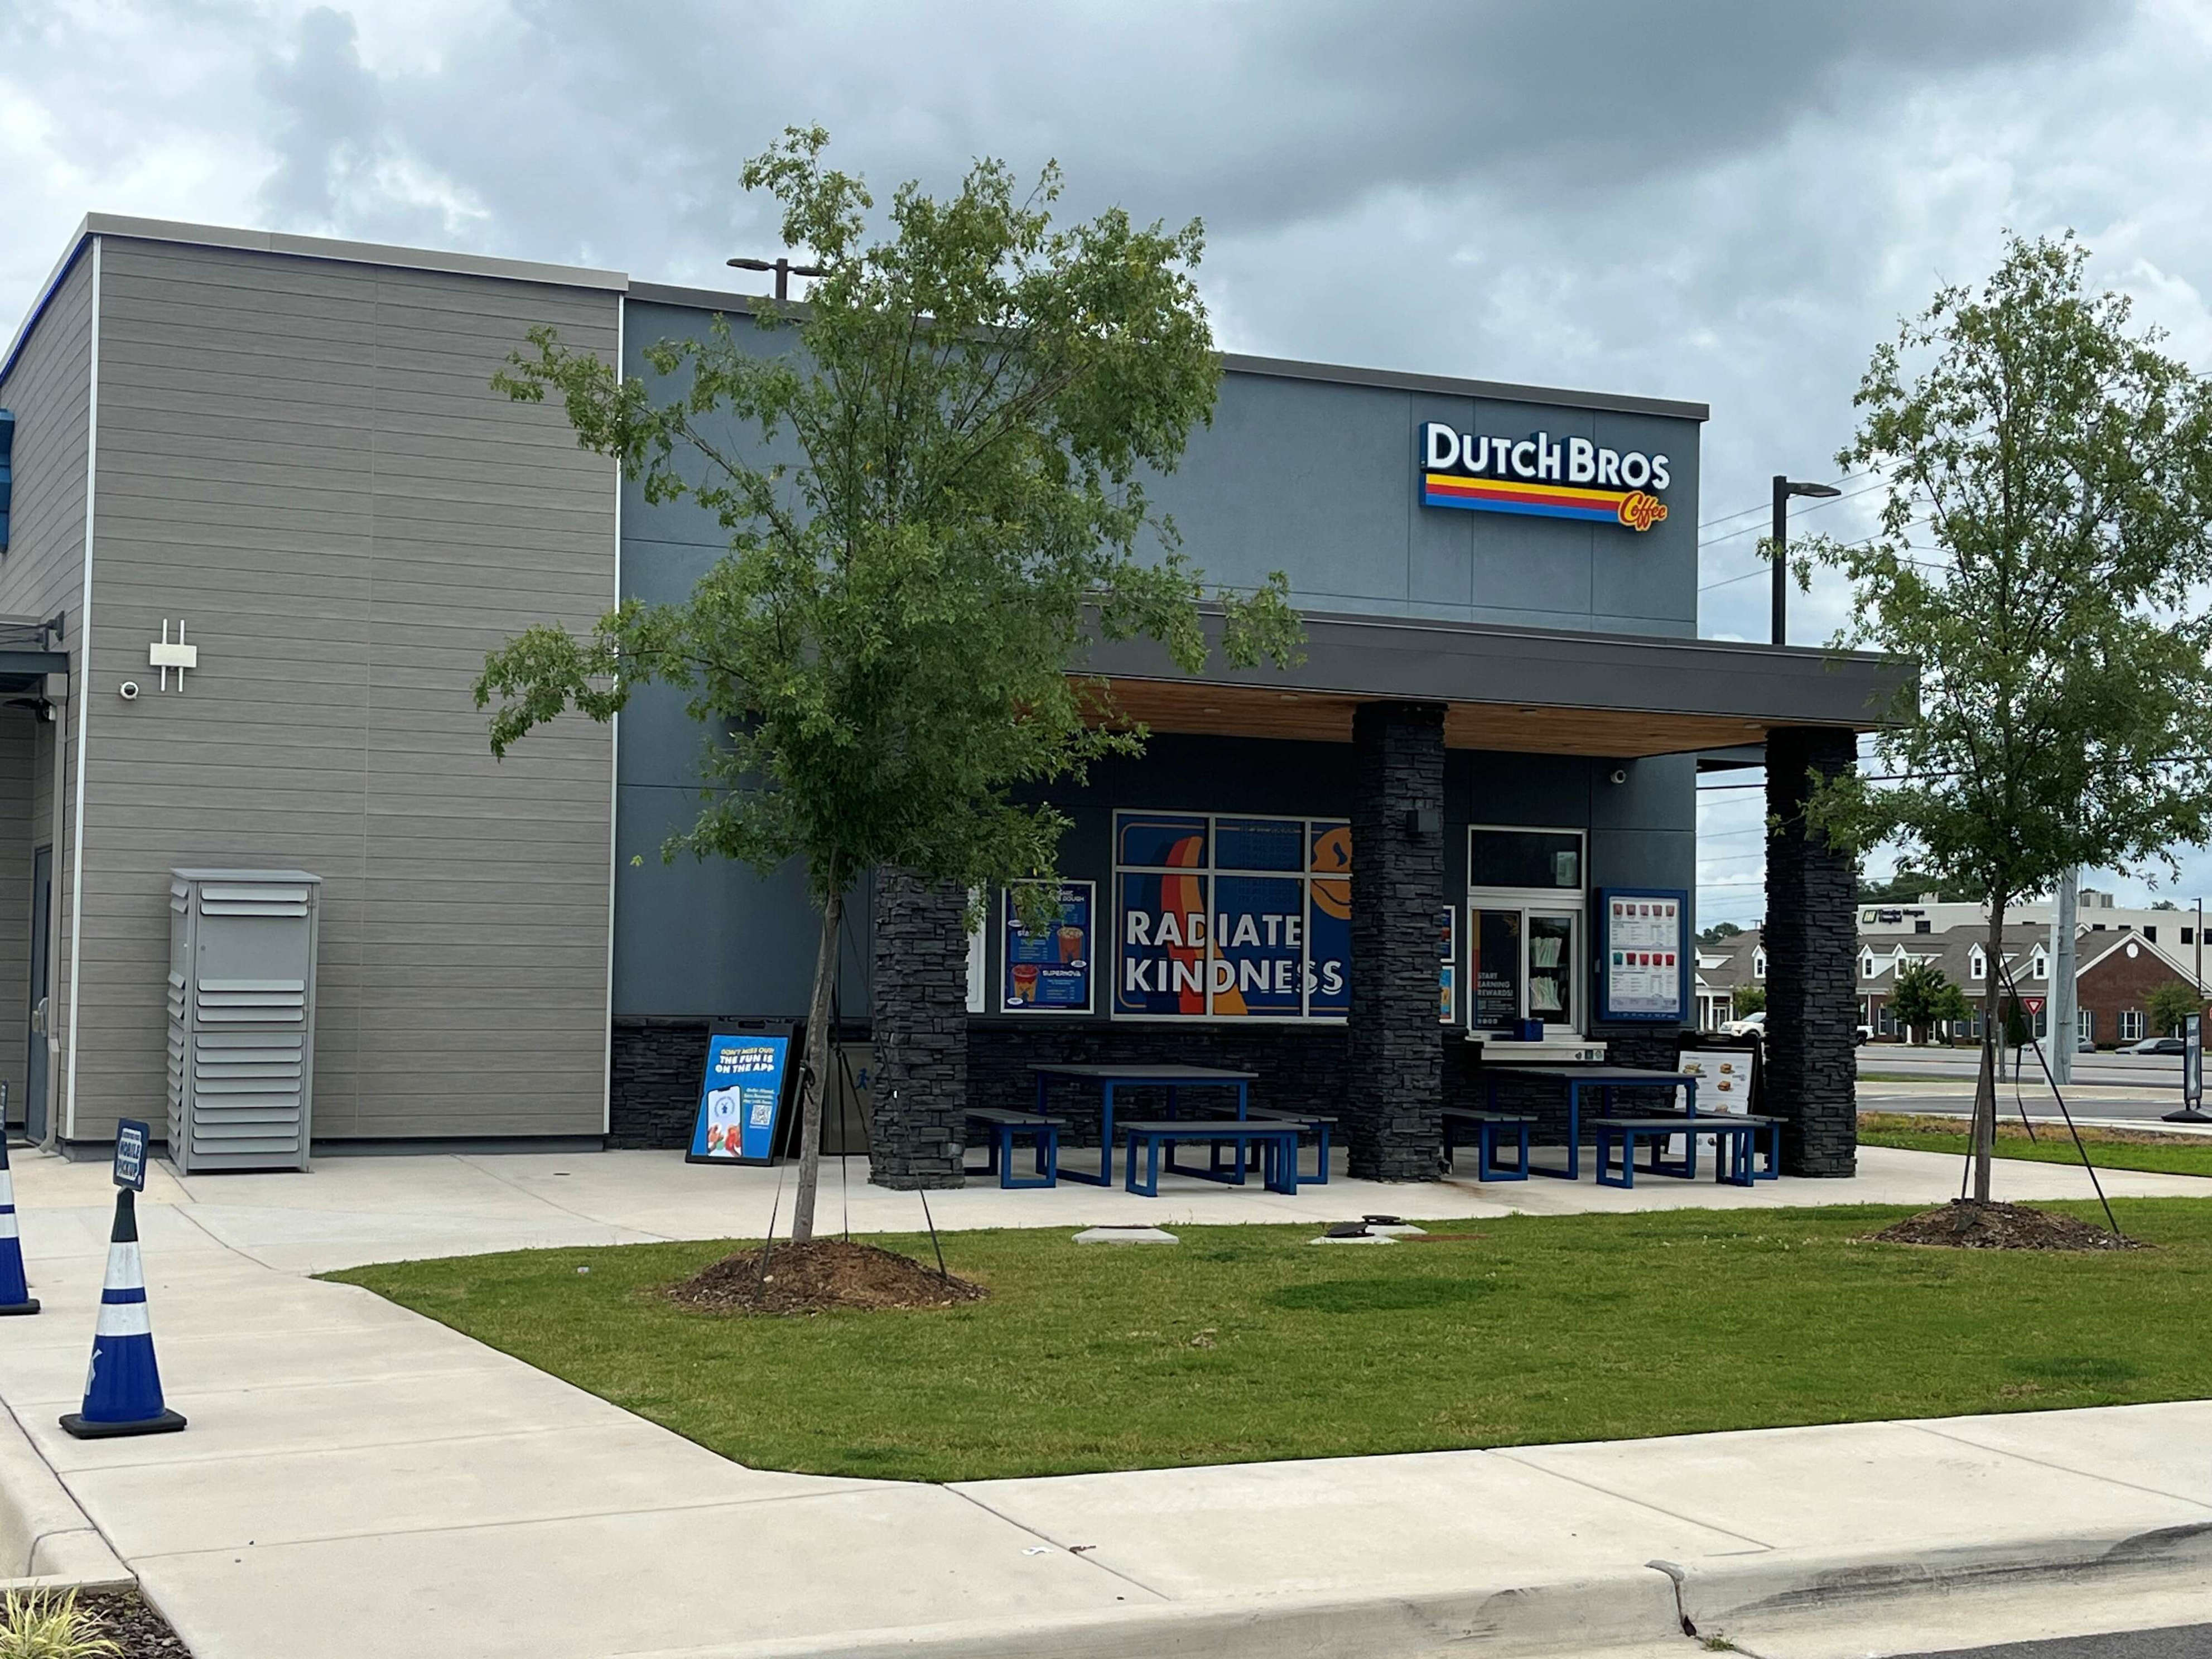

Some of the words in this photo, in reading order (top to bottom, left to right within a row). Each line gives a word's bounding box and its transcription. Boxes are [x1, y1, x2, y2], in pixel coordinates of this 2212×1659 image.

[1569, 437, 1670, 490] BROS
[1619, 491, 1666, 531] Coffee
[1127, 911, 1301, 948] RADIATE
[1126, 958, 1343, 995] KINDNESS
[715, 1064, 731, 1074] ON
[732, 1063, 752, 1073] THE
[753, 1063, 774, 1072] APP
[720, 1055, 738, 1064] THE
[739, 1054, 761, 1063] FUN
[763, 1054, 774, 1063] IS
[119, 1140, 141, 1159] MOBILE
[117, 1159, 139, 1177] PICKUP
